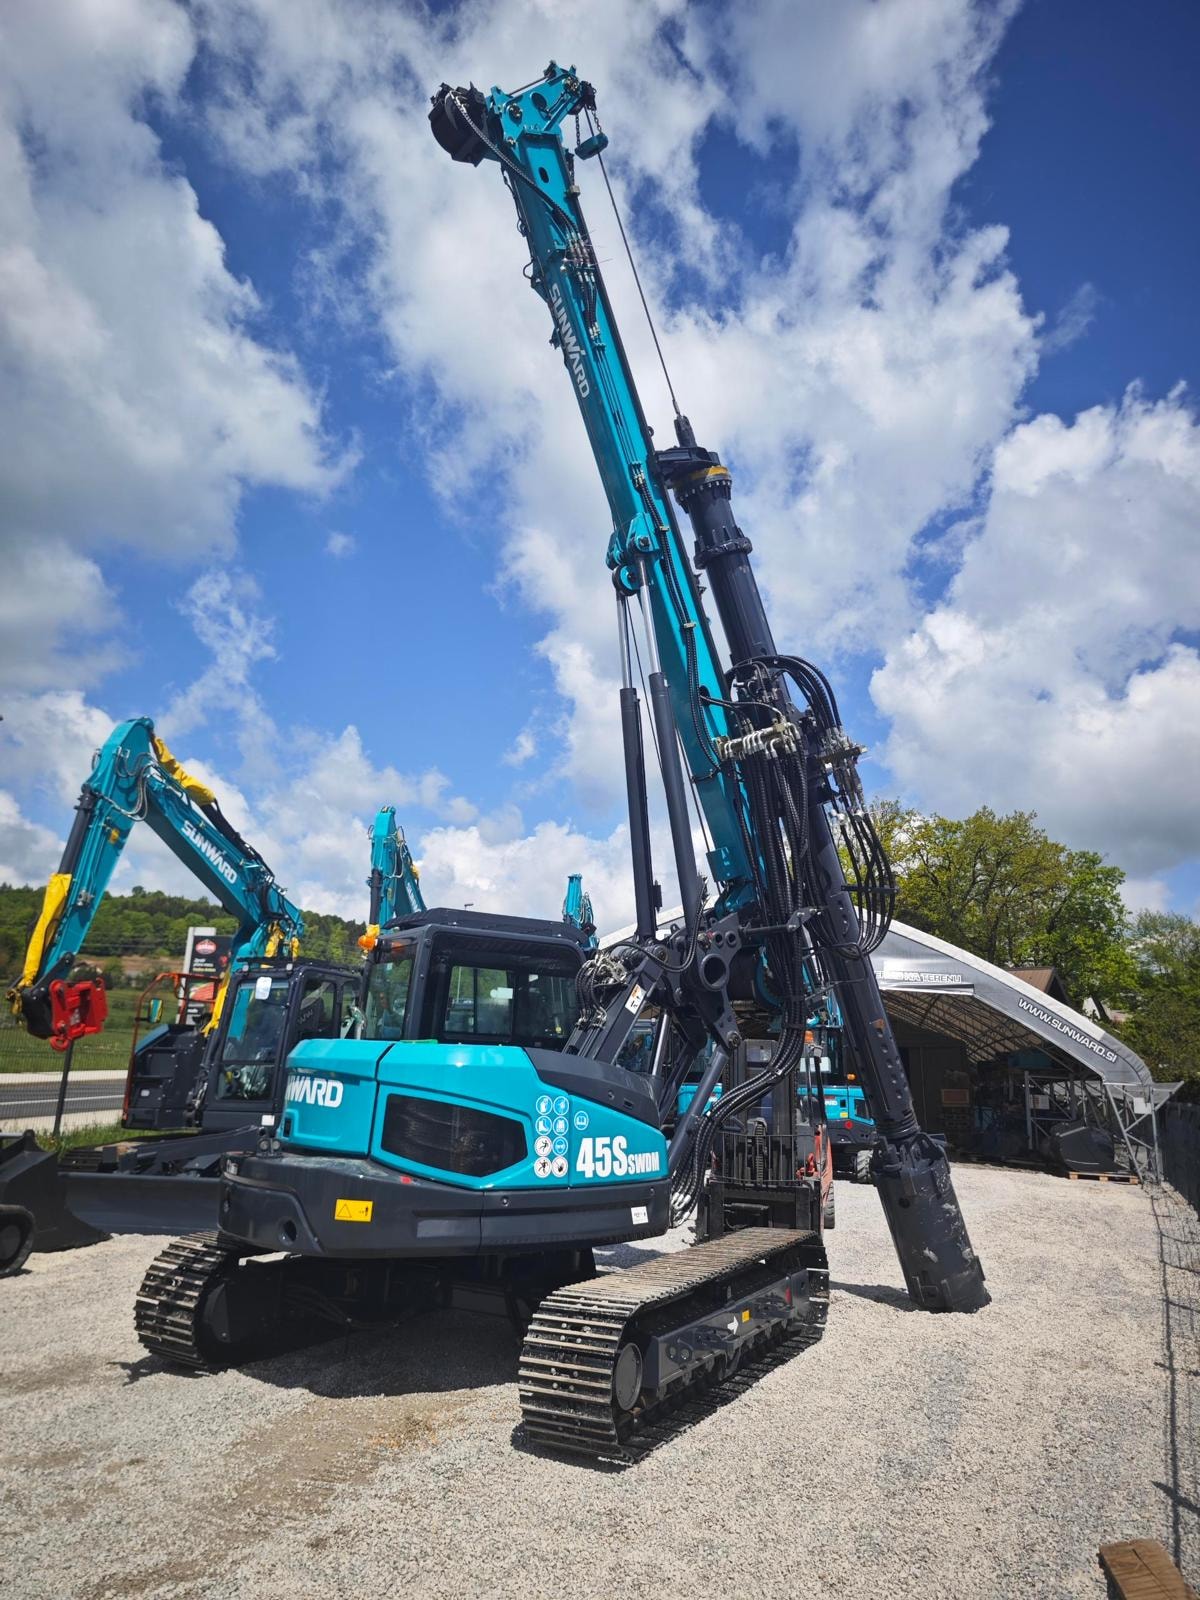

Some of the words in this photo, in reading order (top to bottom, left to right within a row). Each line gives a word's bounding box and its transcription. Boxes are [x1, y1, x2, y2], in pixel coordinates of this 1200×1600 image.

[549, 283, 590, 398] SUNWARD
[181, 820, 237, 884] SUNWARD
[923, 973, 962, 984] TERENU
[1018, 999, 1117, 1063] WWW.SUNWARD.SI
[627, 1151, 660, 1175] SWDM
